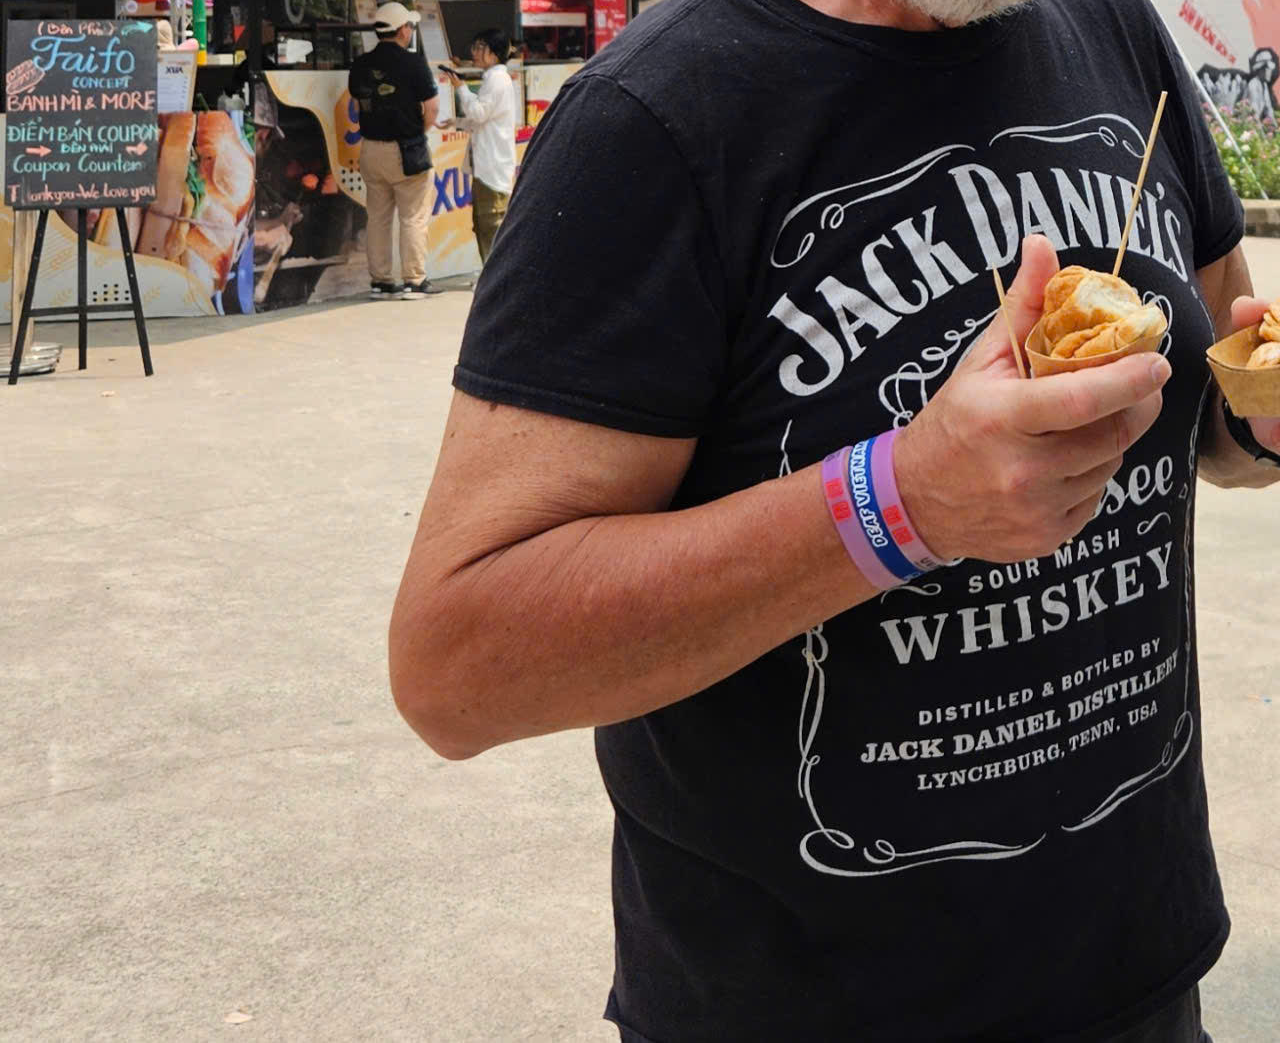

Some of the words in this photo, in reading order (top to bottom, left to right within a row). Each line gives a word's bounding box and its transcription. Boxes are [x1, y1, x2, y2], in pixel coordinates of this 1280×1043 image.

[97, 123, 159, 143] COUPON
[101, 90, 156, 112] MORE
[767, 206, 979, 397] JACK
[947, 163, 1189, 283] DANIEL'S
[859, 506, 889, 548] DEAF
[968, 559, 1041, 594] SOUR
[1054, 528, 1121, 567] MASH
[880, 541, 1174, 665] WHISKEY
[860, 738, 944, 763] JACK
[953, 709, 1061, 755] DANIEL
[1068, 648, 1178, 722] DISTILLERY
[919, 687, 1033, 726] DISTILLED
[1042, 681, 1054, 698] &
[1061, 648, 1135, 691] BOTTLED
[1141, 638, 1161, 658] BY
[917, 744, 1065, 790] LYNCHBURG,
[1128, 700, 1159, 727] USA
